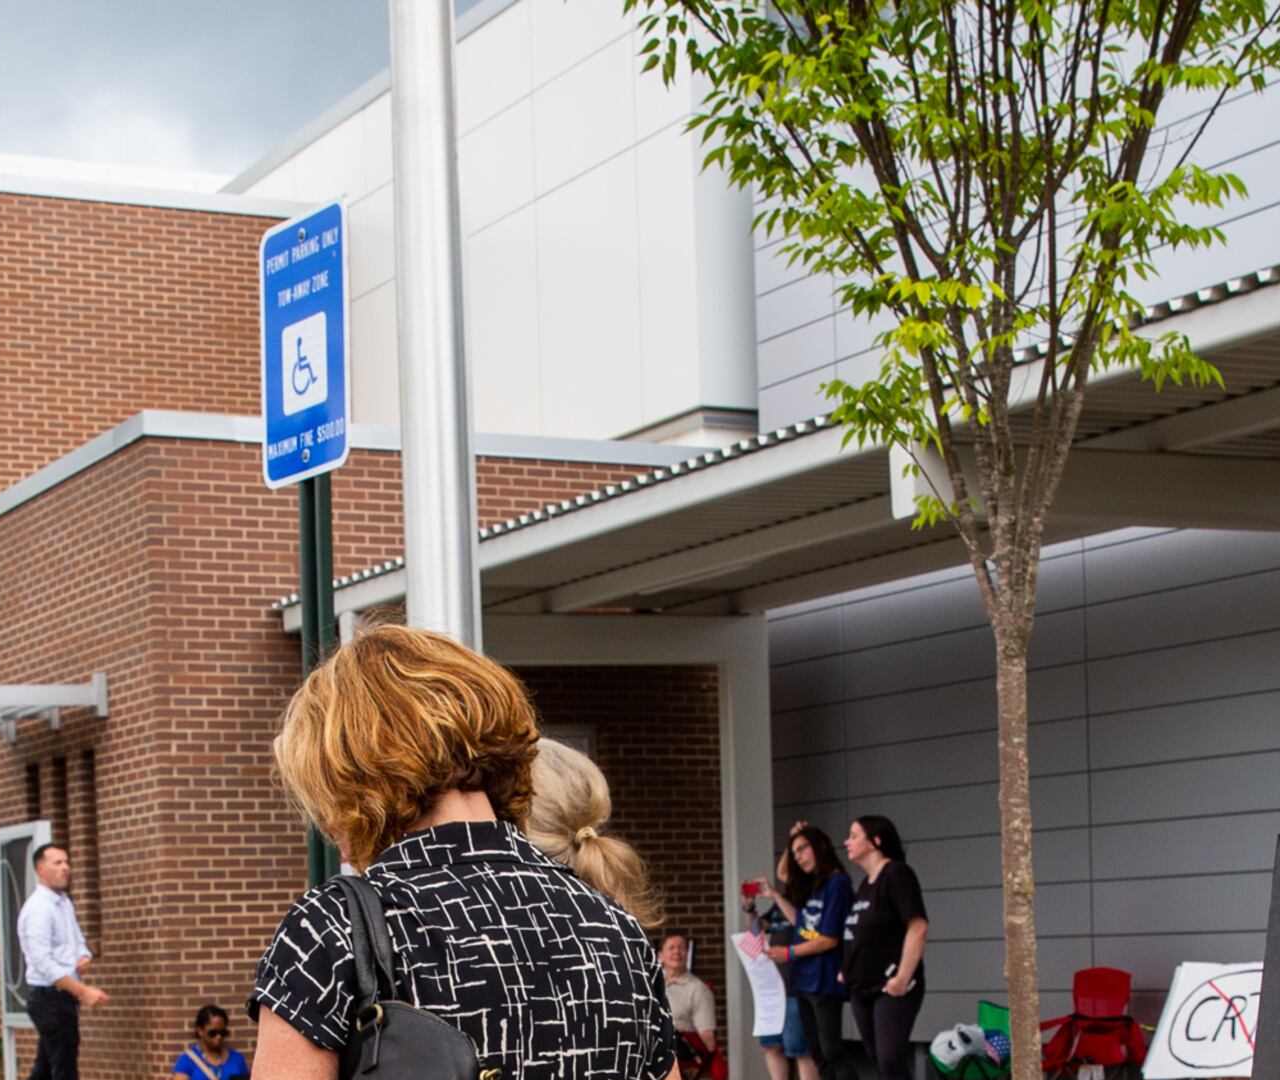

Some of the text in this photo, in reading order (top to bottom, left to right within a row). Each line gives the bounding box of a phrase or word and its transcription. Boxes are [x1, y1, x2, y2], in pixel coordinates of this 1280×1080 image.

[291, 235, 319, 264] PARKING
[322, 225, 339, 249] ONLY
[277, 269, 330, 308] TOW-AWAY ZONE
[300, 429, 314, 449] FINE
